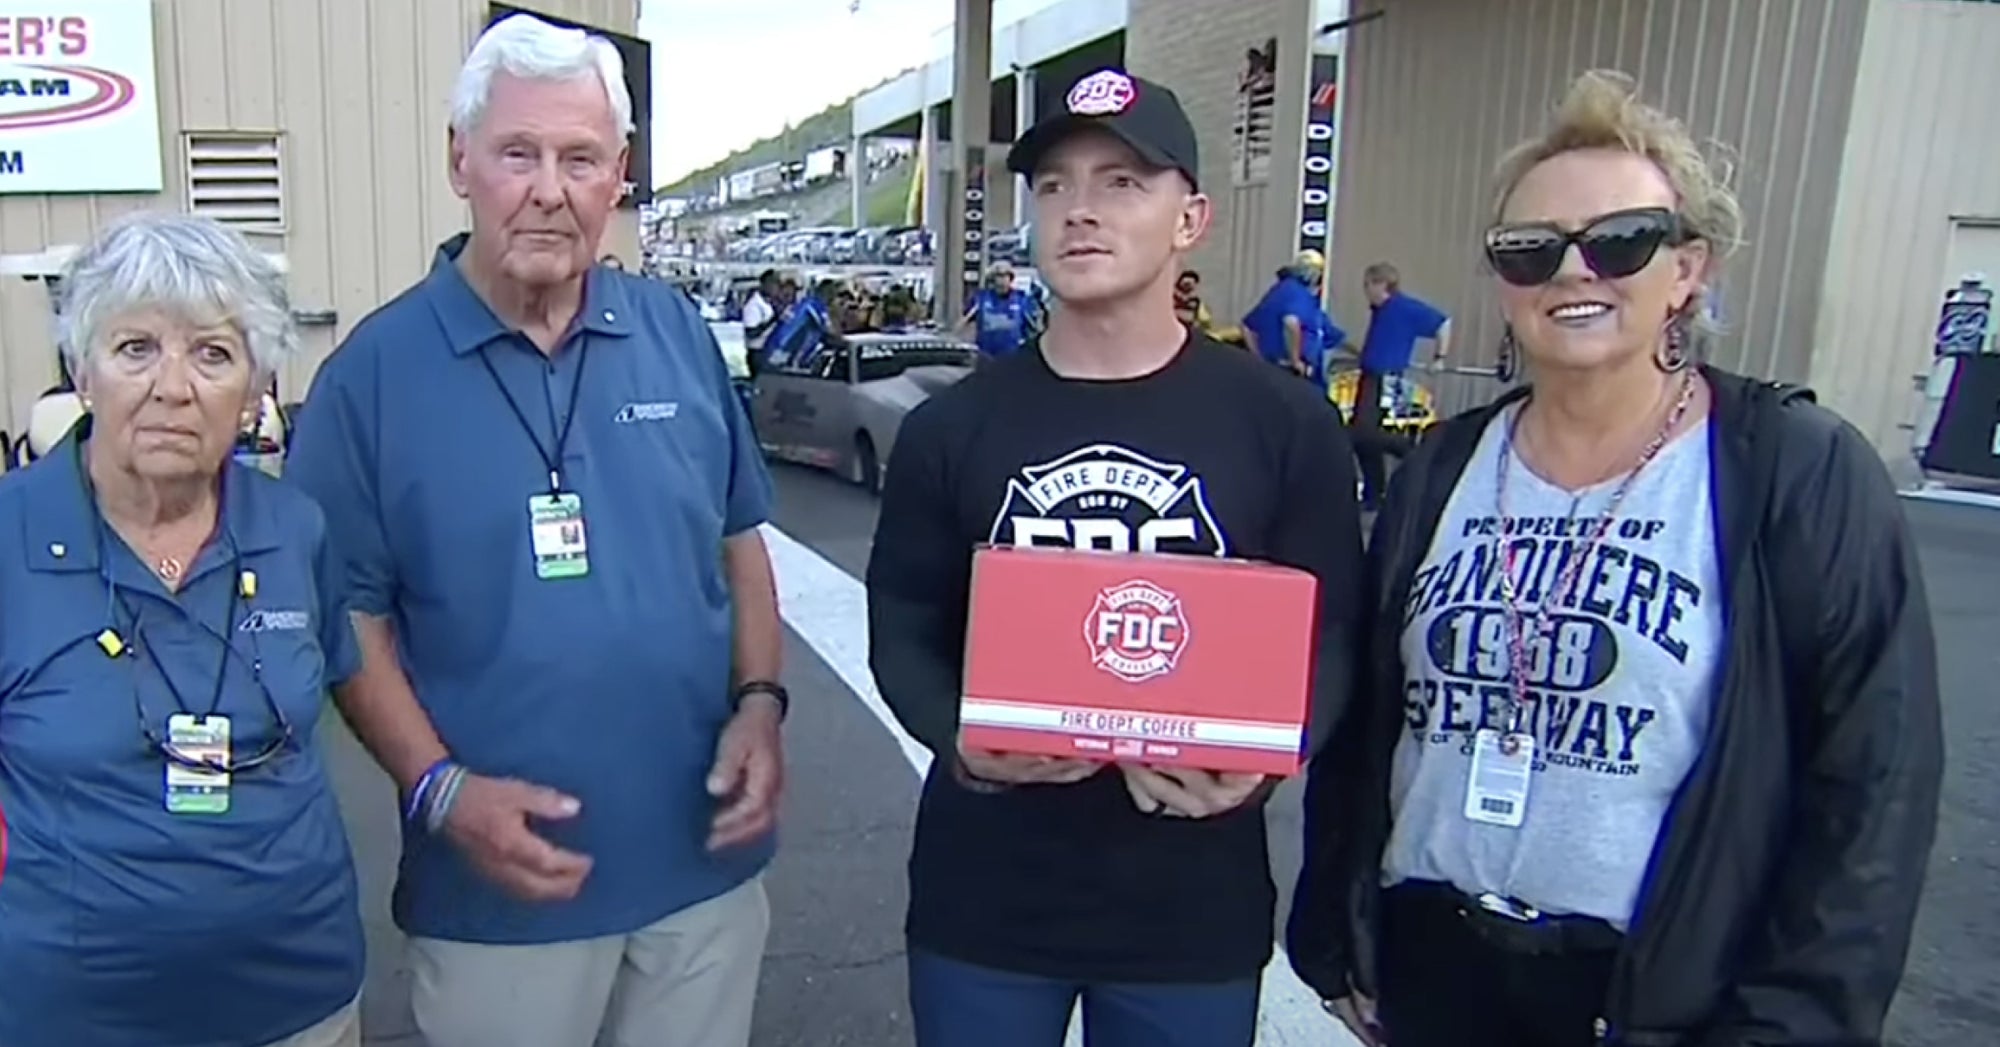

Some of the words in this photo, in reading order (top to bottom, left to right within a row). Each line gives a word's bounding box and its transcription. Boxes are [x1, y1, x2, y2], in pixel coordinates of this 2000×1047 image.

[1073, 80, 1130, 105] FDC
[1302, 123, 1333, 237] DODG
[1040, 467, 1092, 501] FIRE
[1619, 518, 1666, 541] OF
[1096, 611, 1178, 652] FDC
[1061, 711, 1092, 729] FIRE
[1141, 718, 1197, 738] COFFEE
